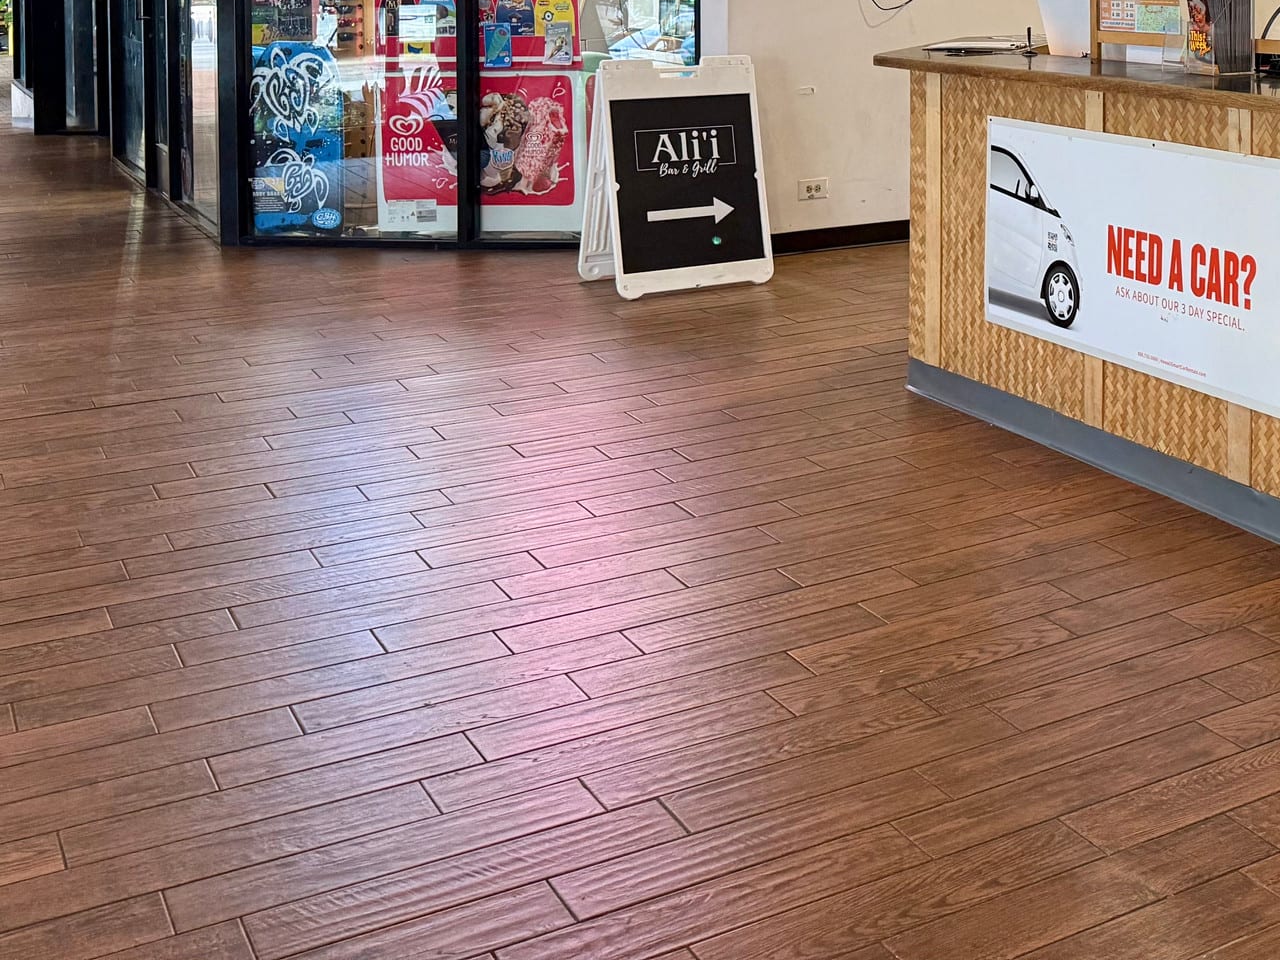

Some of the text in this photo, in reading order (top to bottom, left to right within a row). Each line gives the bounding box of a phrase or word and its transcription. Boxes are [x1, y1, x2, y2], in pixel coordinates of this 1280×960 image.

[390, 137, 423, 152] GOOD
[651, 129, 720, 163] Ali'i
[385, 152, 430, 166] HUMOR
[659, 159, 718, 178] Bar & Grill
[1107, 224, 1257, 311] NEED A CAR?
[1115, 286, 1246, 331] ASK ABOUT OUR 3 DAY SPECIAL.
